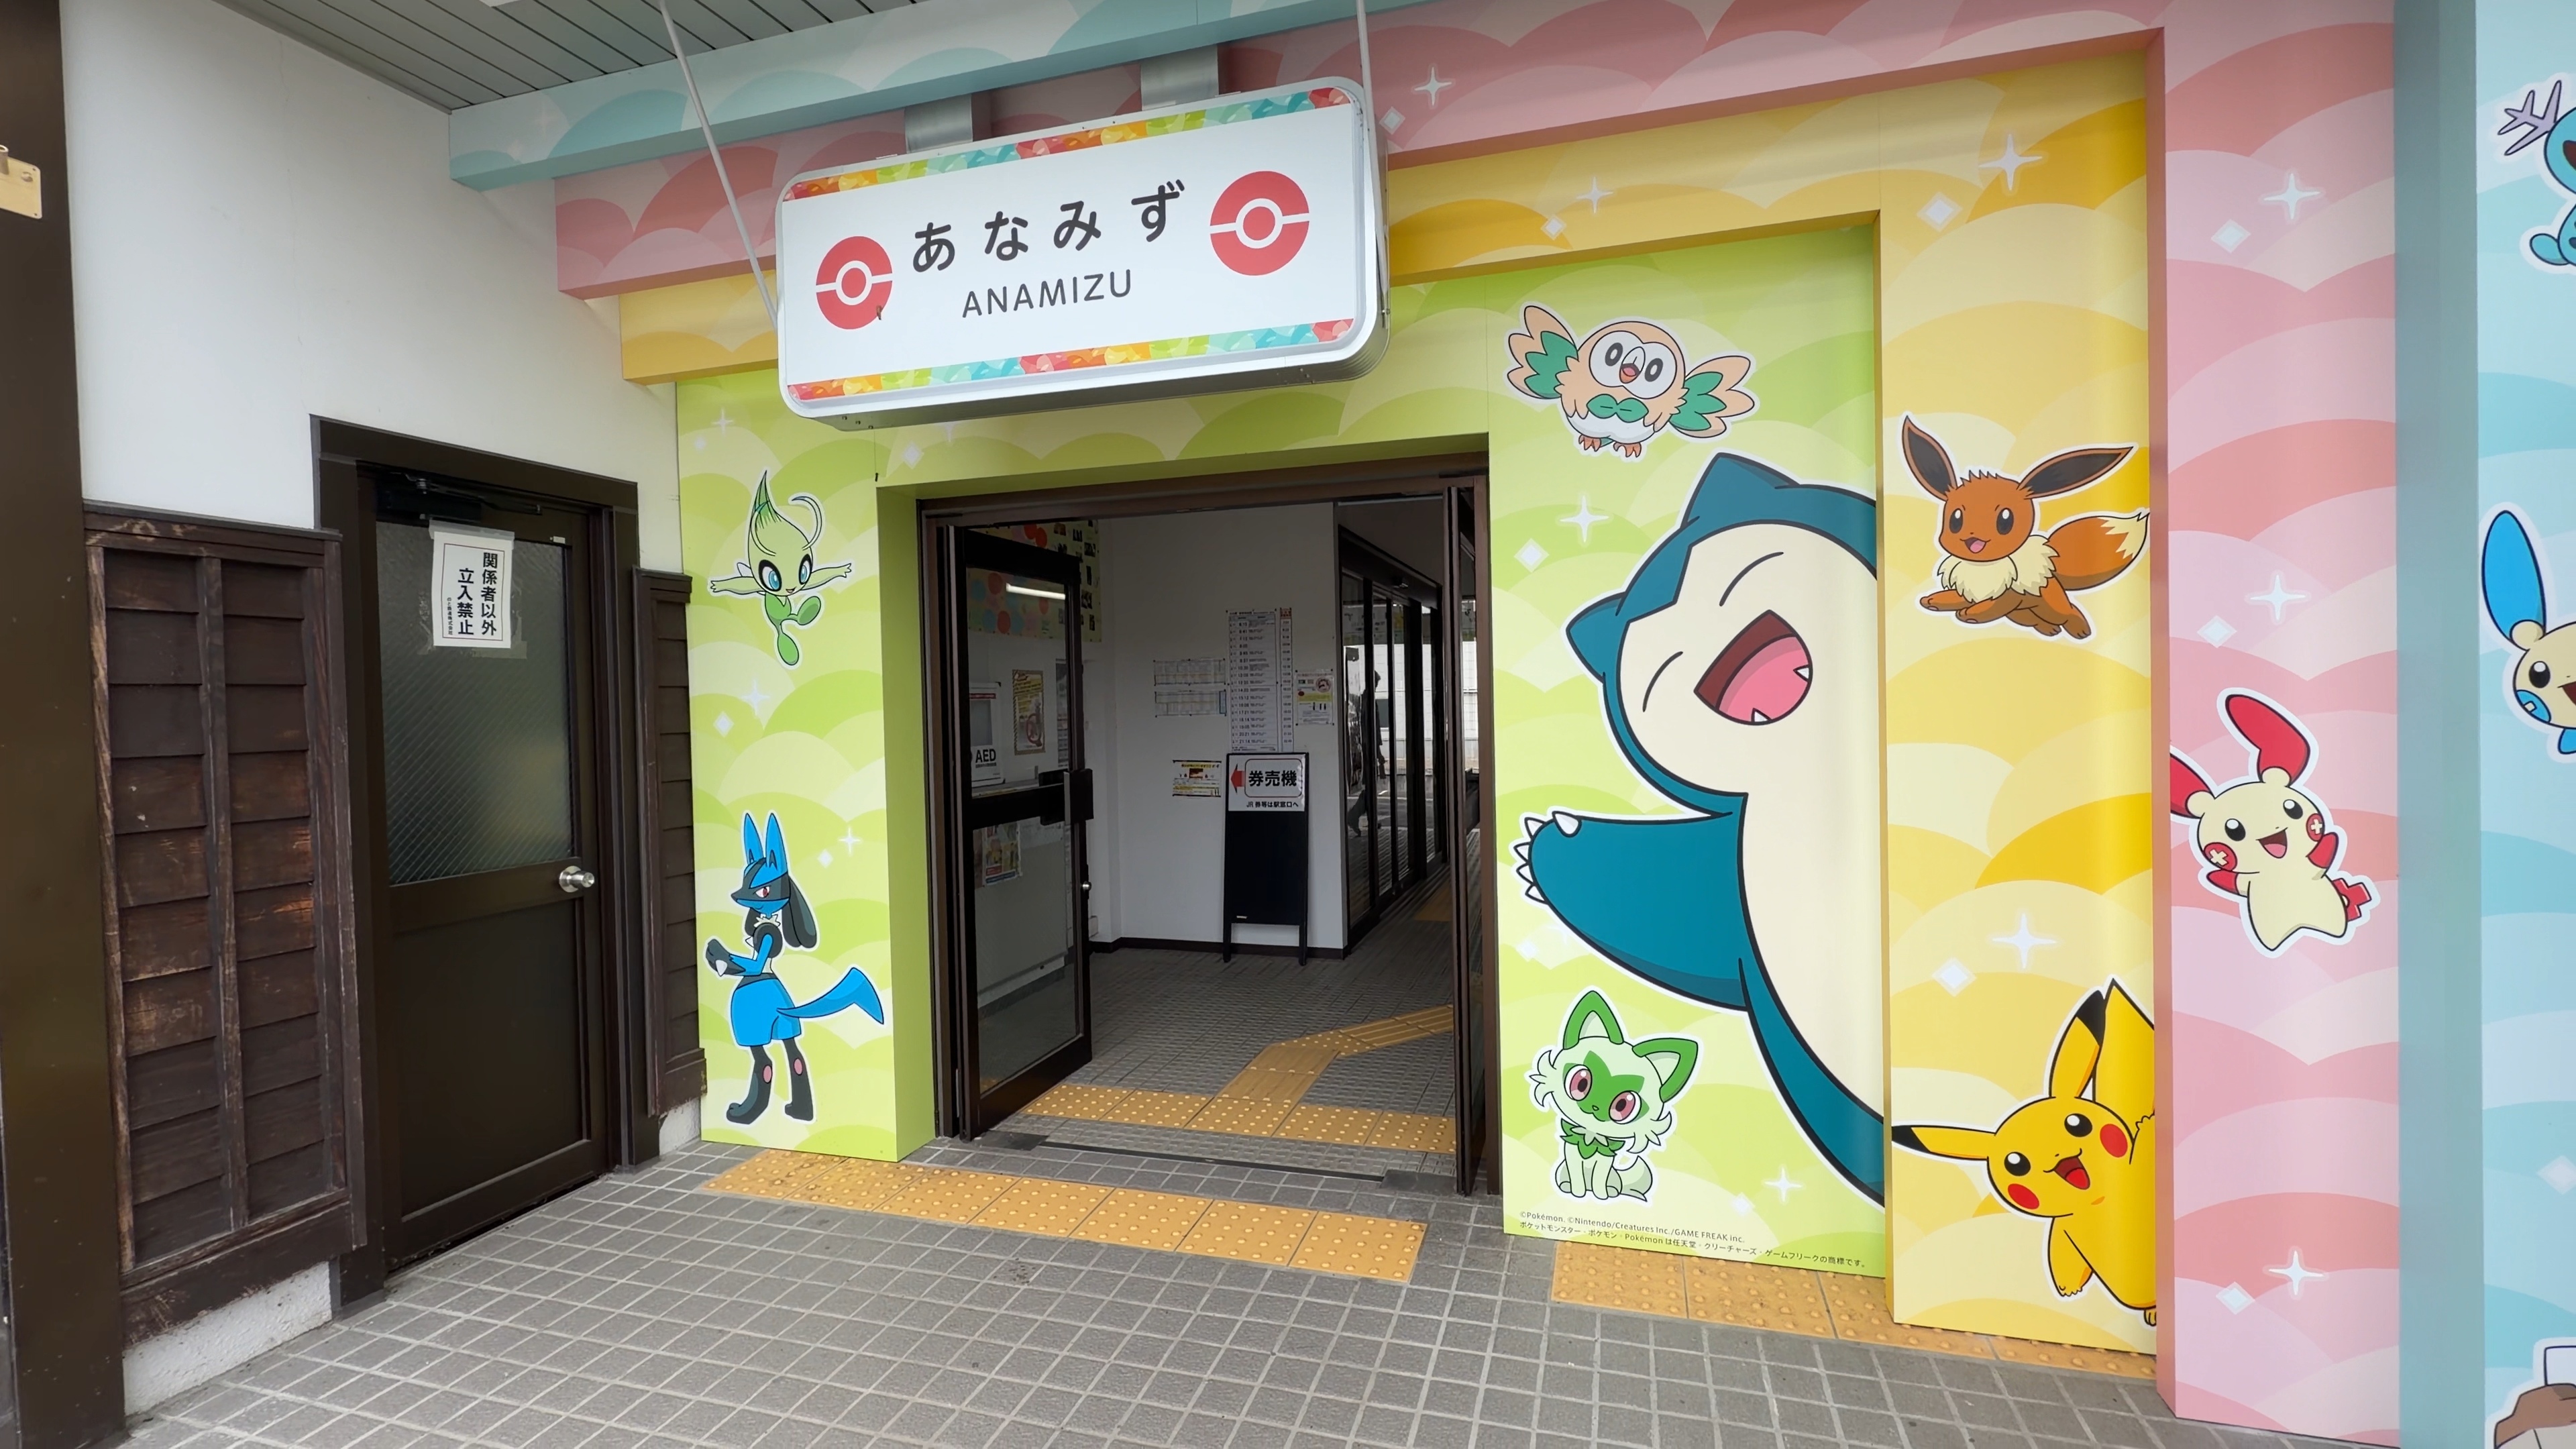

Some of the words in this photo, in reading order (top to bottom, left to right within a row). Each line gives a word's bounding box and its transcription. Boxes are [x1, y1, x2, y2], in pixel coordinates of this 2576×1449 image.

[912, 180, 1185, 274] あなみず
[962, 269, 1132, 319] ANAMIZU
[457, 568, 474, 636] 立入禁止
[480, 552, 498, 636] 関係者以外
[975, 749, 996, 763] AED
[1248, 770, 1297, 787] 券売機
[1656, 1226, 1699, 1238] Inc./GAME
[1701, 1232, 1728, 1240] FREAK
